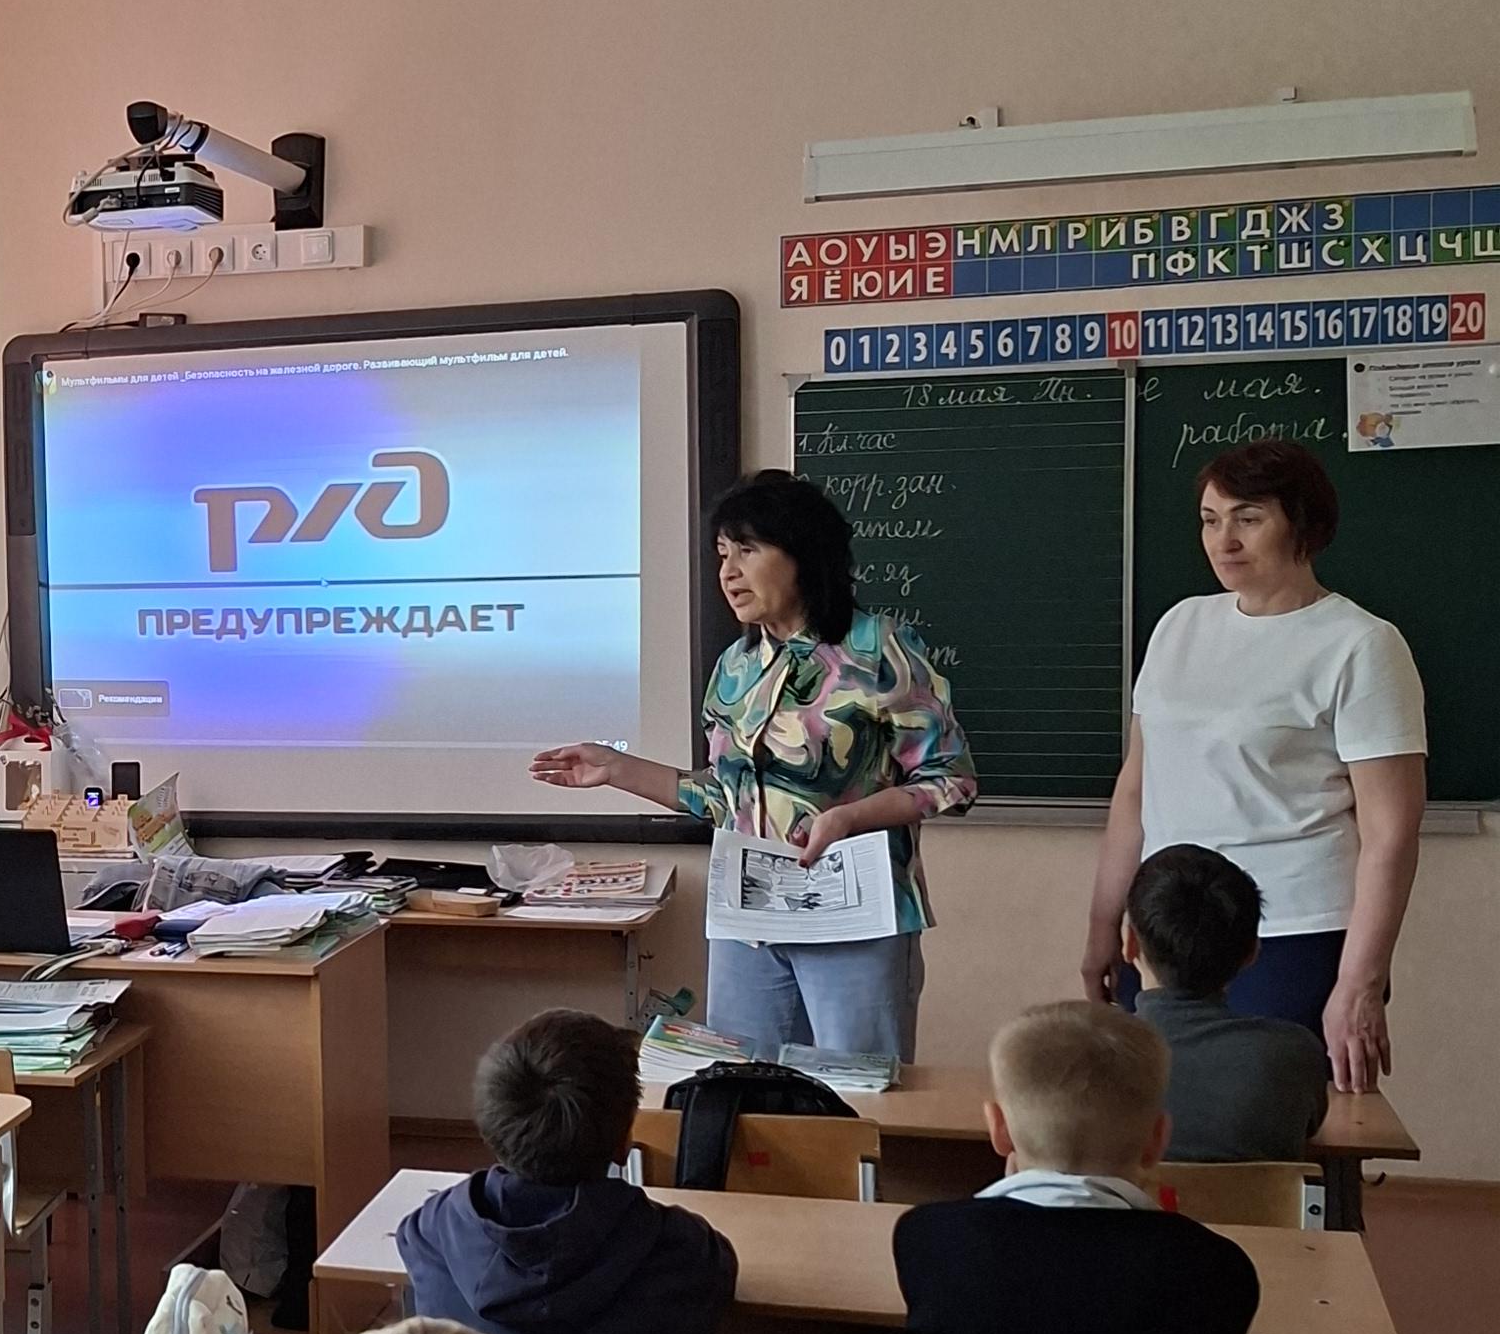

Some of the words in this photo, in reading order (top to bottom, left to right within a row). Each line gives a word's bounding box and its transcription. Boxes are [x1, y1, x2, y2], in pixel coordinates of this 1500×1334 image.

[787, 242, 813, 267] А
[819, 239, 847, 265] О
[856, 236, 879, 262] У
[889, 234, 915, 261] Ы
[925, 232, 946, 259] Э
[957, 230, 980, 256] Н
[989, 227, 1020, 254] М
[1026, 225, 1051, 251] Л
[1067, 223, 1086, 249] Р
[1100, 218, 1125, 248] Й
[1134, 218, 1154, 245] Б
[1172, 216, 1192, 242] В
[1210, 212, 1229, 239] Г
[1240, 209, 1271, 239] Д
[1278, 206, 1312, 234] Ж
[1322, 203, 1344, 230] З
[789, 276, 808, 301] Я
[824, 270, 841, 299] Ё
[853, 271, 882, 298] Ю
[888, 269, 913, 296] И
[926, 267, 945, 293] Е
[1132, 252, 1155, 279] П
[1166, 251, 1196, 276] Ф
[1208, 248, 1231, 275] К
[1247, 244, 1267, 271] Т
[1279, 242, 1311, 269] Ш
[1321, 239, 1345, 266] С
[1360, 237, 1385, 264] Х
[1400, 235, 1427, 263] Ц
[1440, 232, 1462, 257] Ч
[830, 336, 846, 366] 0
[858, 335, 870, 364] 1
[885, 334, 900, 363] 2
[913, 332, 927, 362] 3
[940, 330, 957, 360] 4
[969, 329, 984, 359] 5
[998, 327, 1014, 357] 6
[1027, 325, 1042, 356] 7
[1055, 323, 1071, 354] 8
[1084, 321, 1100, 352] 9
[1110, 319, 1137, 350] 10
[1144, 317, 1168, 348] 11
[1177, 316, 1204, 347] 12
[1211, 314, 1238, 345] 13
[1245, 312, 1274, 343] 14
[1280, 310, 1307, 341] 15
[1314, 308, 1343, 339] 16
[1349, 306, 1377, 337] 17
[1383, 305, 1412, 337] 18
[1418, 303, 1447, 335] 19
[1451, 301, 1481, 333] 20
[130, 374, 149, 385] для
[150, 371, 179, 383] детей
[255, 368, 269, 377] на
[269, 364, 320, 375] железной
[322, 361, 362, 373] дороге.
[363, 355, 438, 371] Развивающий
[439, 351, 508, 367] мультфильм
[510, 352, 531, 363] для
[533, 348, 570, 361] детей.
[903, 383, 933, 409] 18
[137, 603, 525, 640] ПРЕДУПРЕЖДАЕТ
